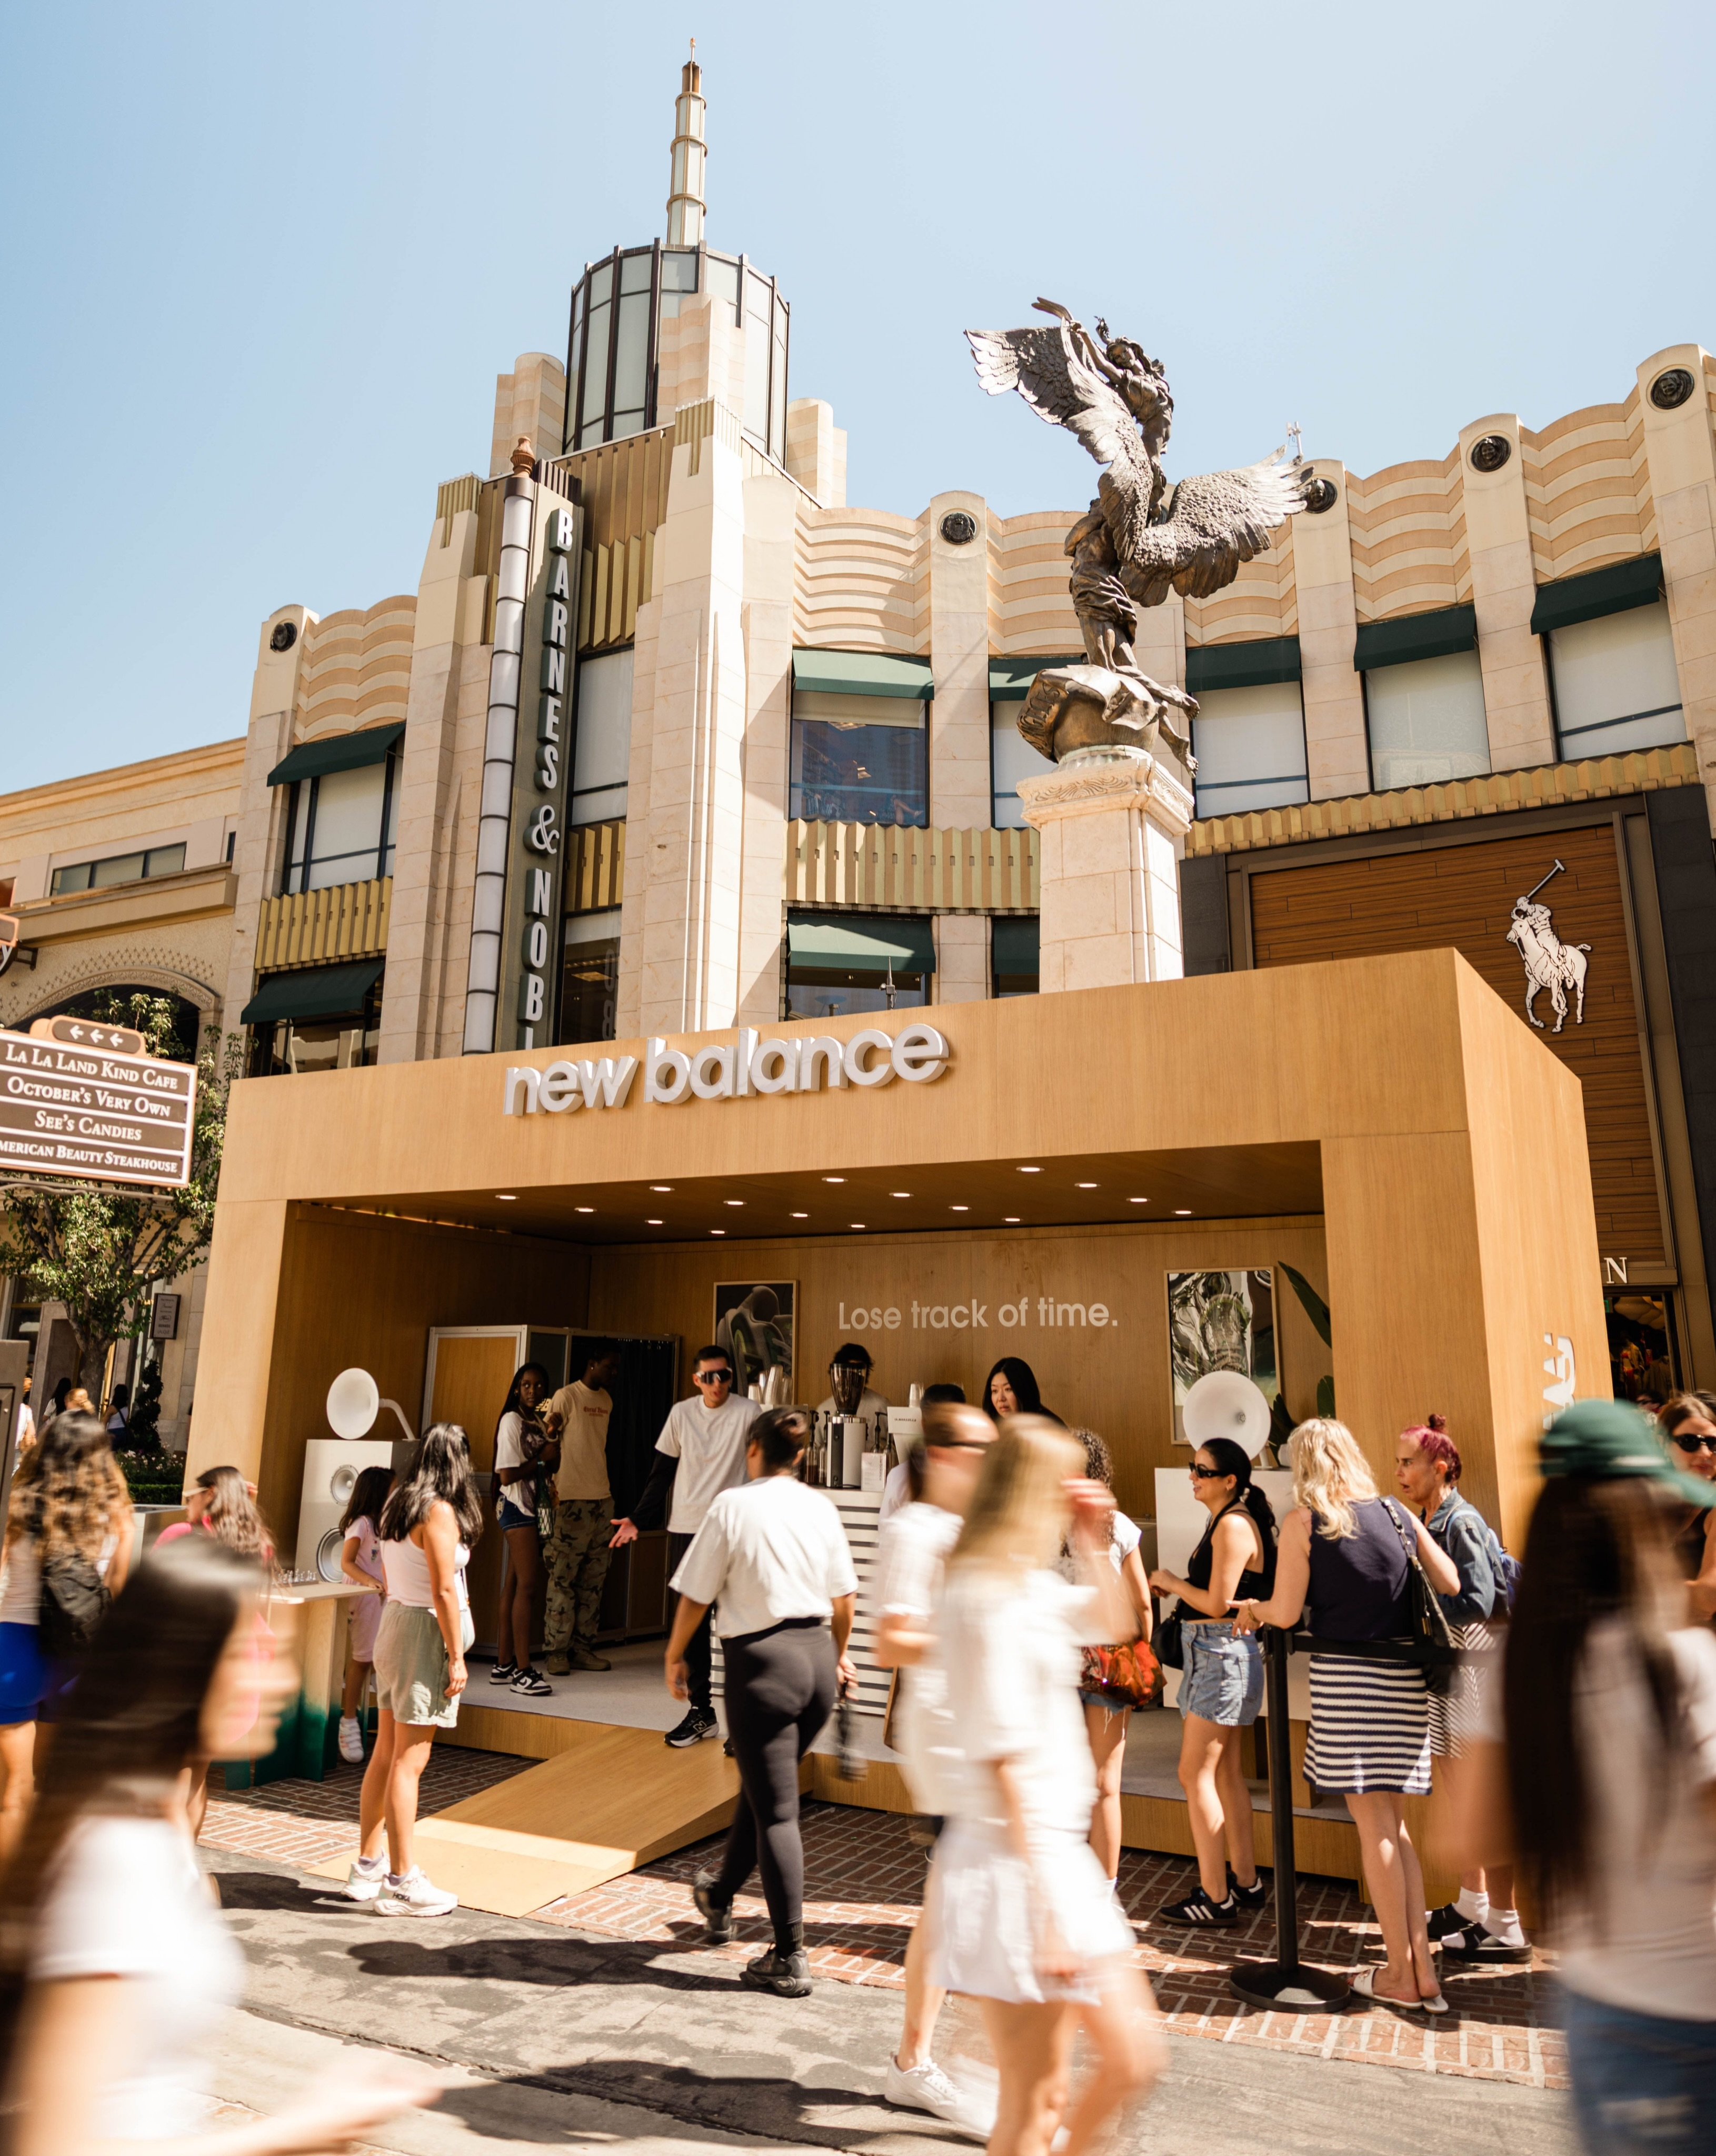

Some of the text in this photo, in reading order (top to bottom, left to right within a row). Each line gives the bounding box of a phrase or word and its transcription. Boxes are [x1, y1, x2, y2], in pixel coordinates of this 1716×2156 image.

[540, 508, 573, 790] BARNES
[526, 804, 560, 855] &
[5, 1043, 178, 1090] LA LA LAND KIND CAFE
[503, 1023, 948, 1116] new balance
[7, 1076, 171, 1117] OCTOBER'S VERY OWN
[35, 1110, 142, 1141] SEE'S CANDIES
[0, 1139, 178, 1173] MERICAN BEAUTY STEAKHOUSE
[839, 1297, 1118, 1330] Lose track of time.
[392, 1892, 410, 1903] HOKA
